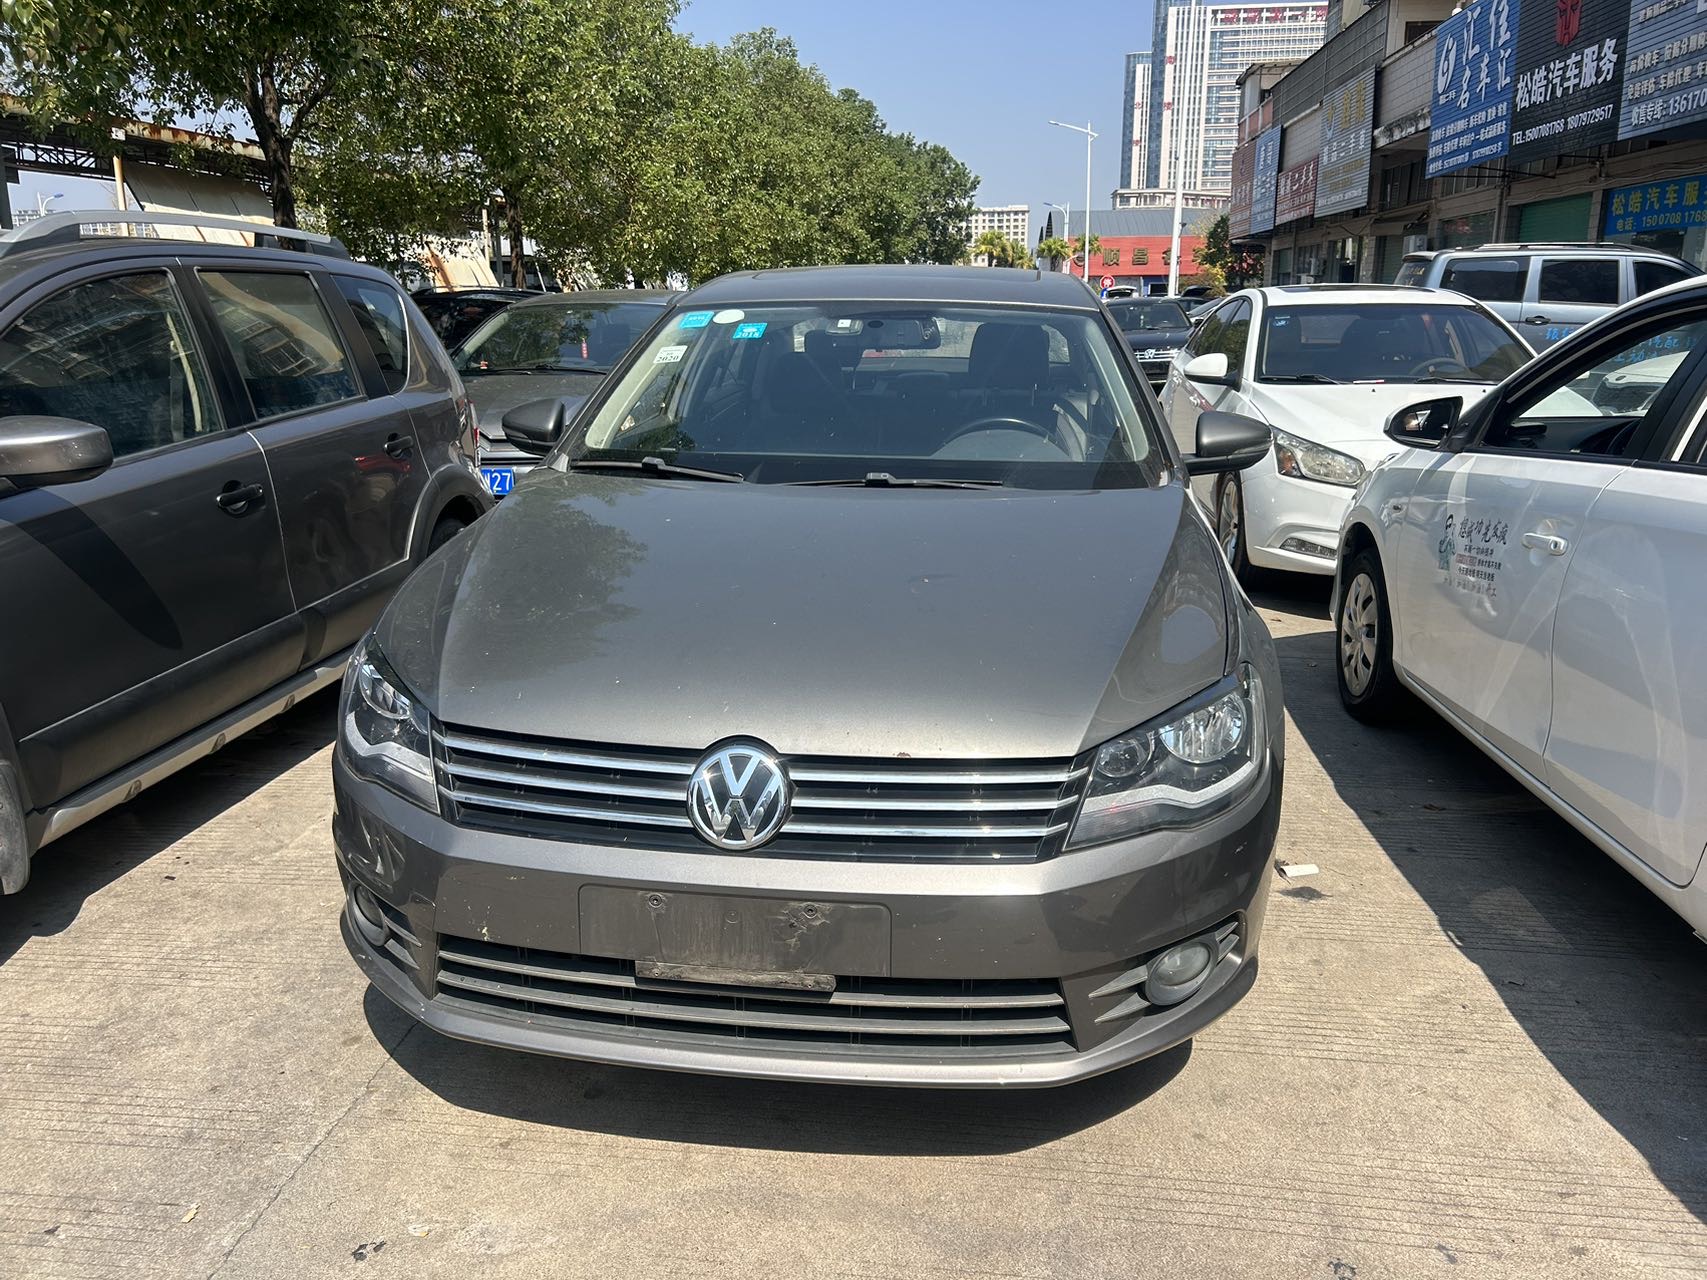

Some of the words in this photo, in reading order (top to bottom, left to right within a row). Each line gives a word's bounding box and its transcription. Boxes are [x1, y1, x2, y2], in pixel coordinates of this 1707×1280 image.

[1516, 38, 1618, 112] 松皓汽车服务
[1612, 181, 1707, 217] 松皓汽车服
